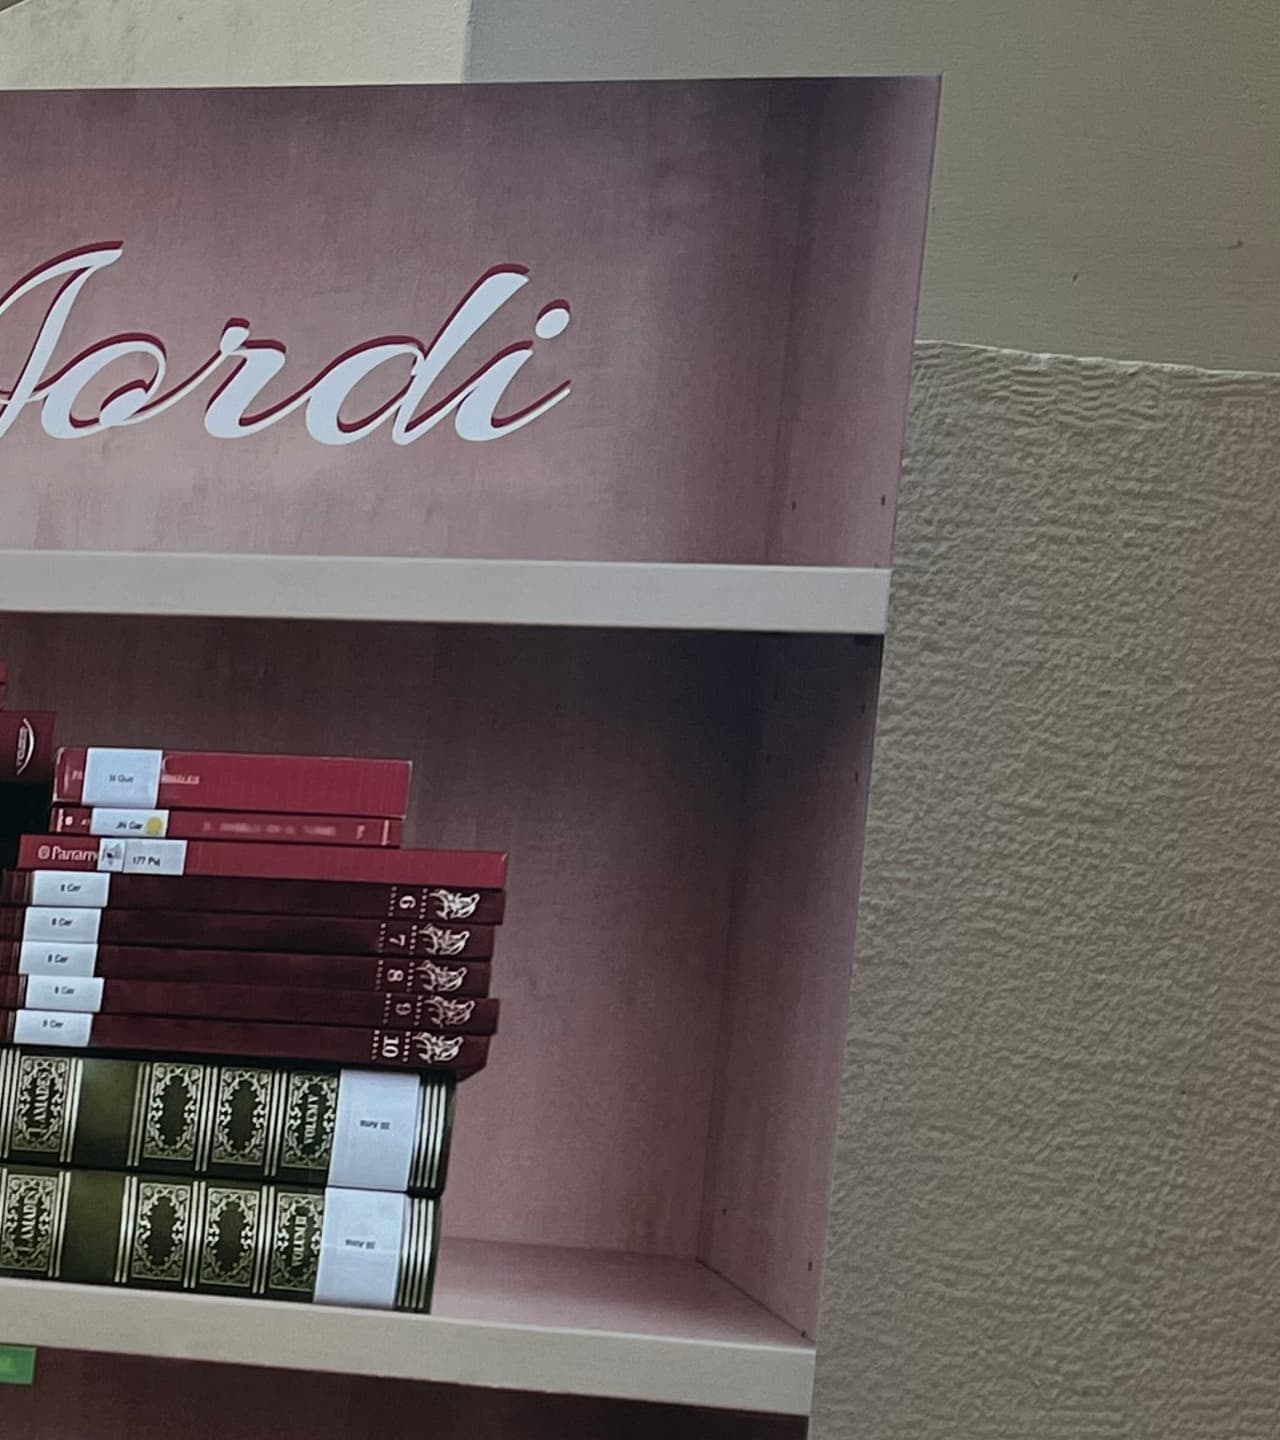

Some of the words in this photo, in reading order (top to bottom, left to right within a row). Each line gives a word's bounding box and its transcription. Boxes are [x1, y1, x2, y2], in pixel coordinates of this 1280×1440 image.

[400, 895, 415, 909] 6
[389, 934, 405, 946] 7
[387, 968, 404, 982] 8
[382, 1036, 399, 1058] 10
